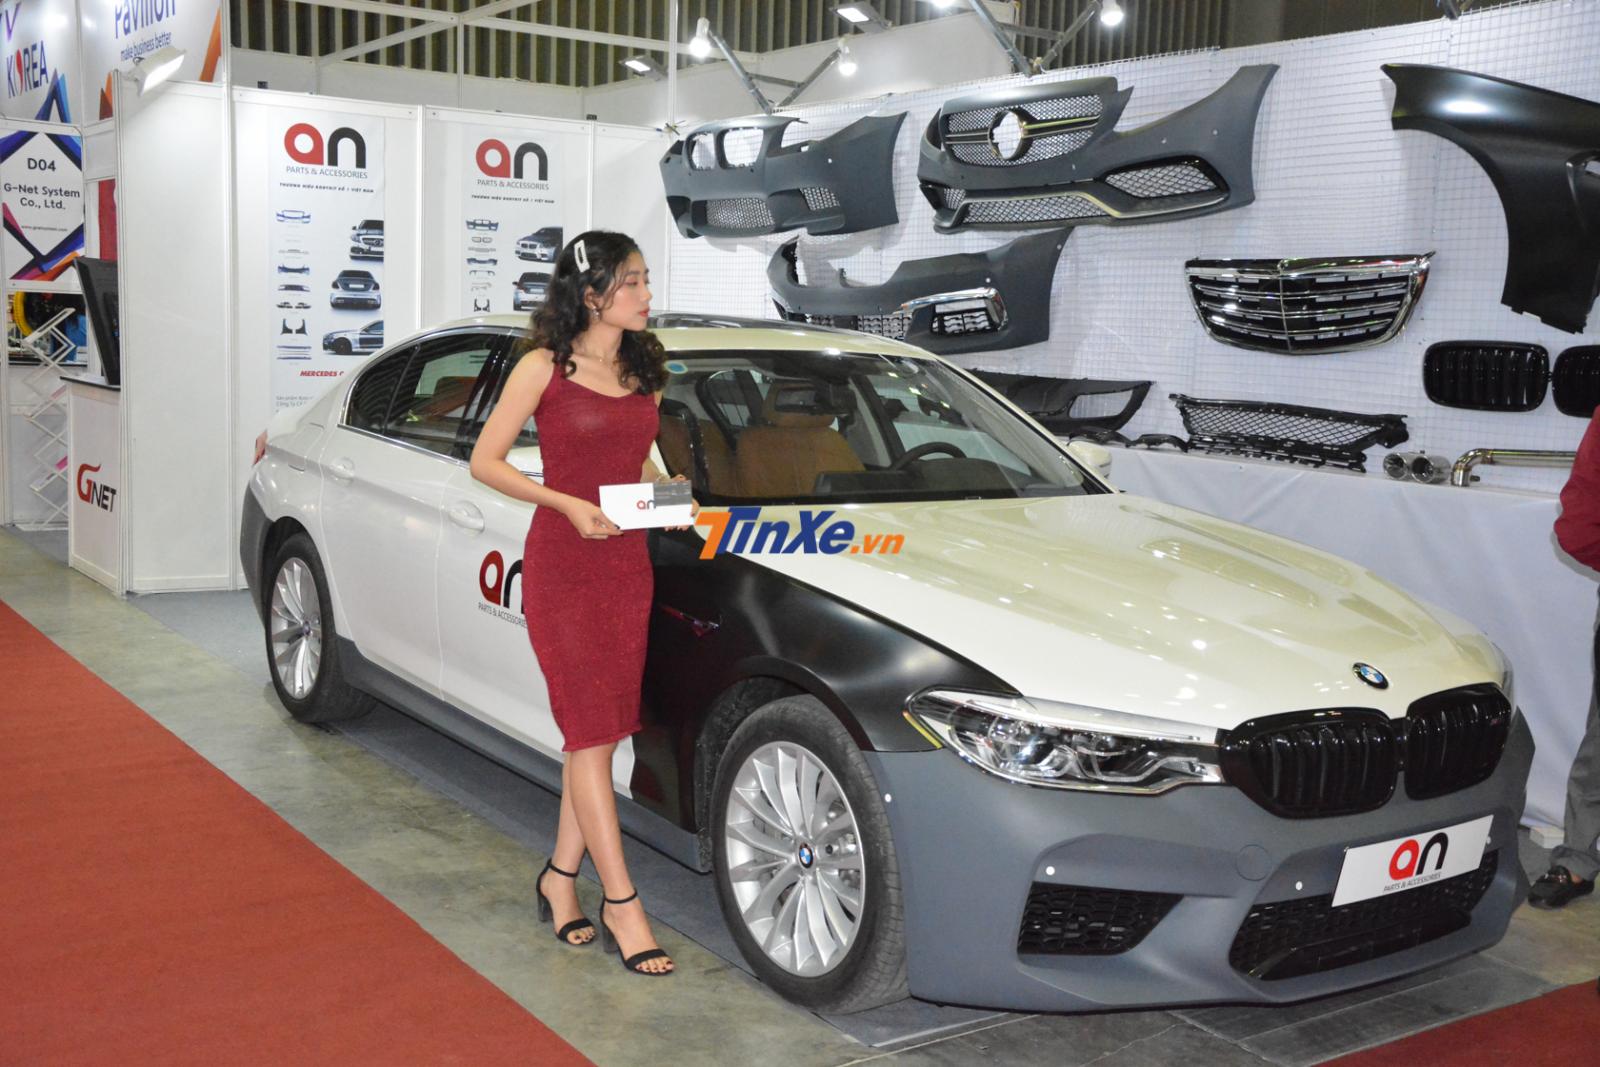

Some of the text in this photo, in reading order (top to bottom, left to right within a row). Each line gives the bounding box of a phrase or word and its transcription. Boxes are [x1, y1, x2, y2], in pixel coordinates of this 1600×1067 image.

[133, 38, 155, 57] business
[155, 31, 172, 49] better
[6, 40, 49, 99] KOREA
[284, 123, 366, 169] an
[27, 157, 56, 171] D04
[475, 138, 548, 181] an
[286, 166, 309, 175] PARTS
[320, 169, 368, 179] ACCESSORIES
[3, 183, 80, 198] G-Net System
[477, 179, 498, 187] PARTS
[507, 181, 550, 190] ACCESSORIES
[20, 197, 66, 210] Co., Ltd.
[77, 463, 117, 513] GNET
[478, 601, 492, 615] PARTS
[1389, 832, 1449, 880] an
[1383, 882, 1401, 892] PARTS
[1407, 871, 1442, 887] ACCESSORIES
